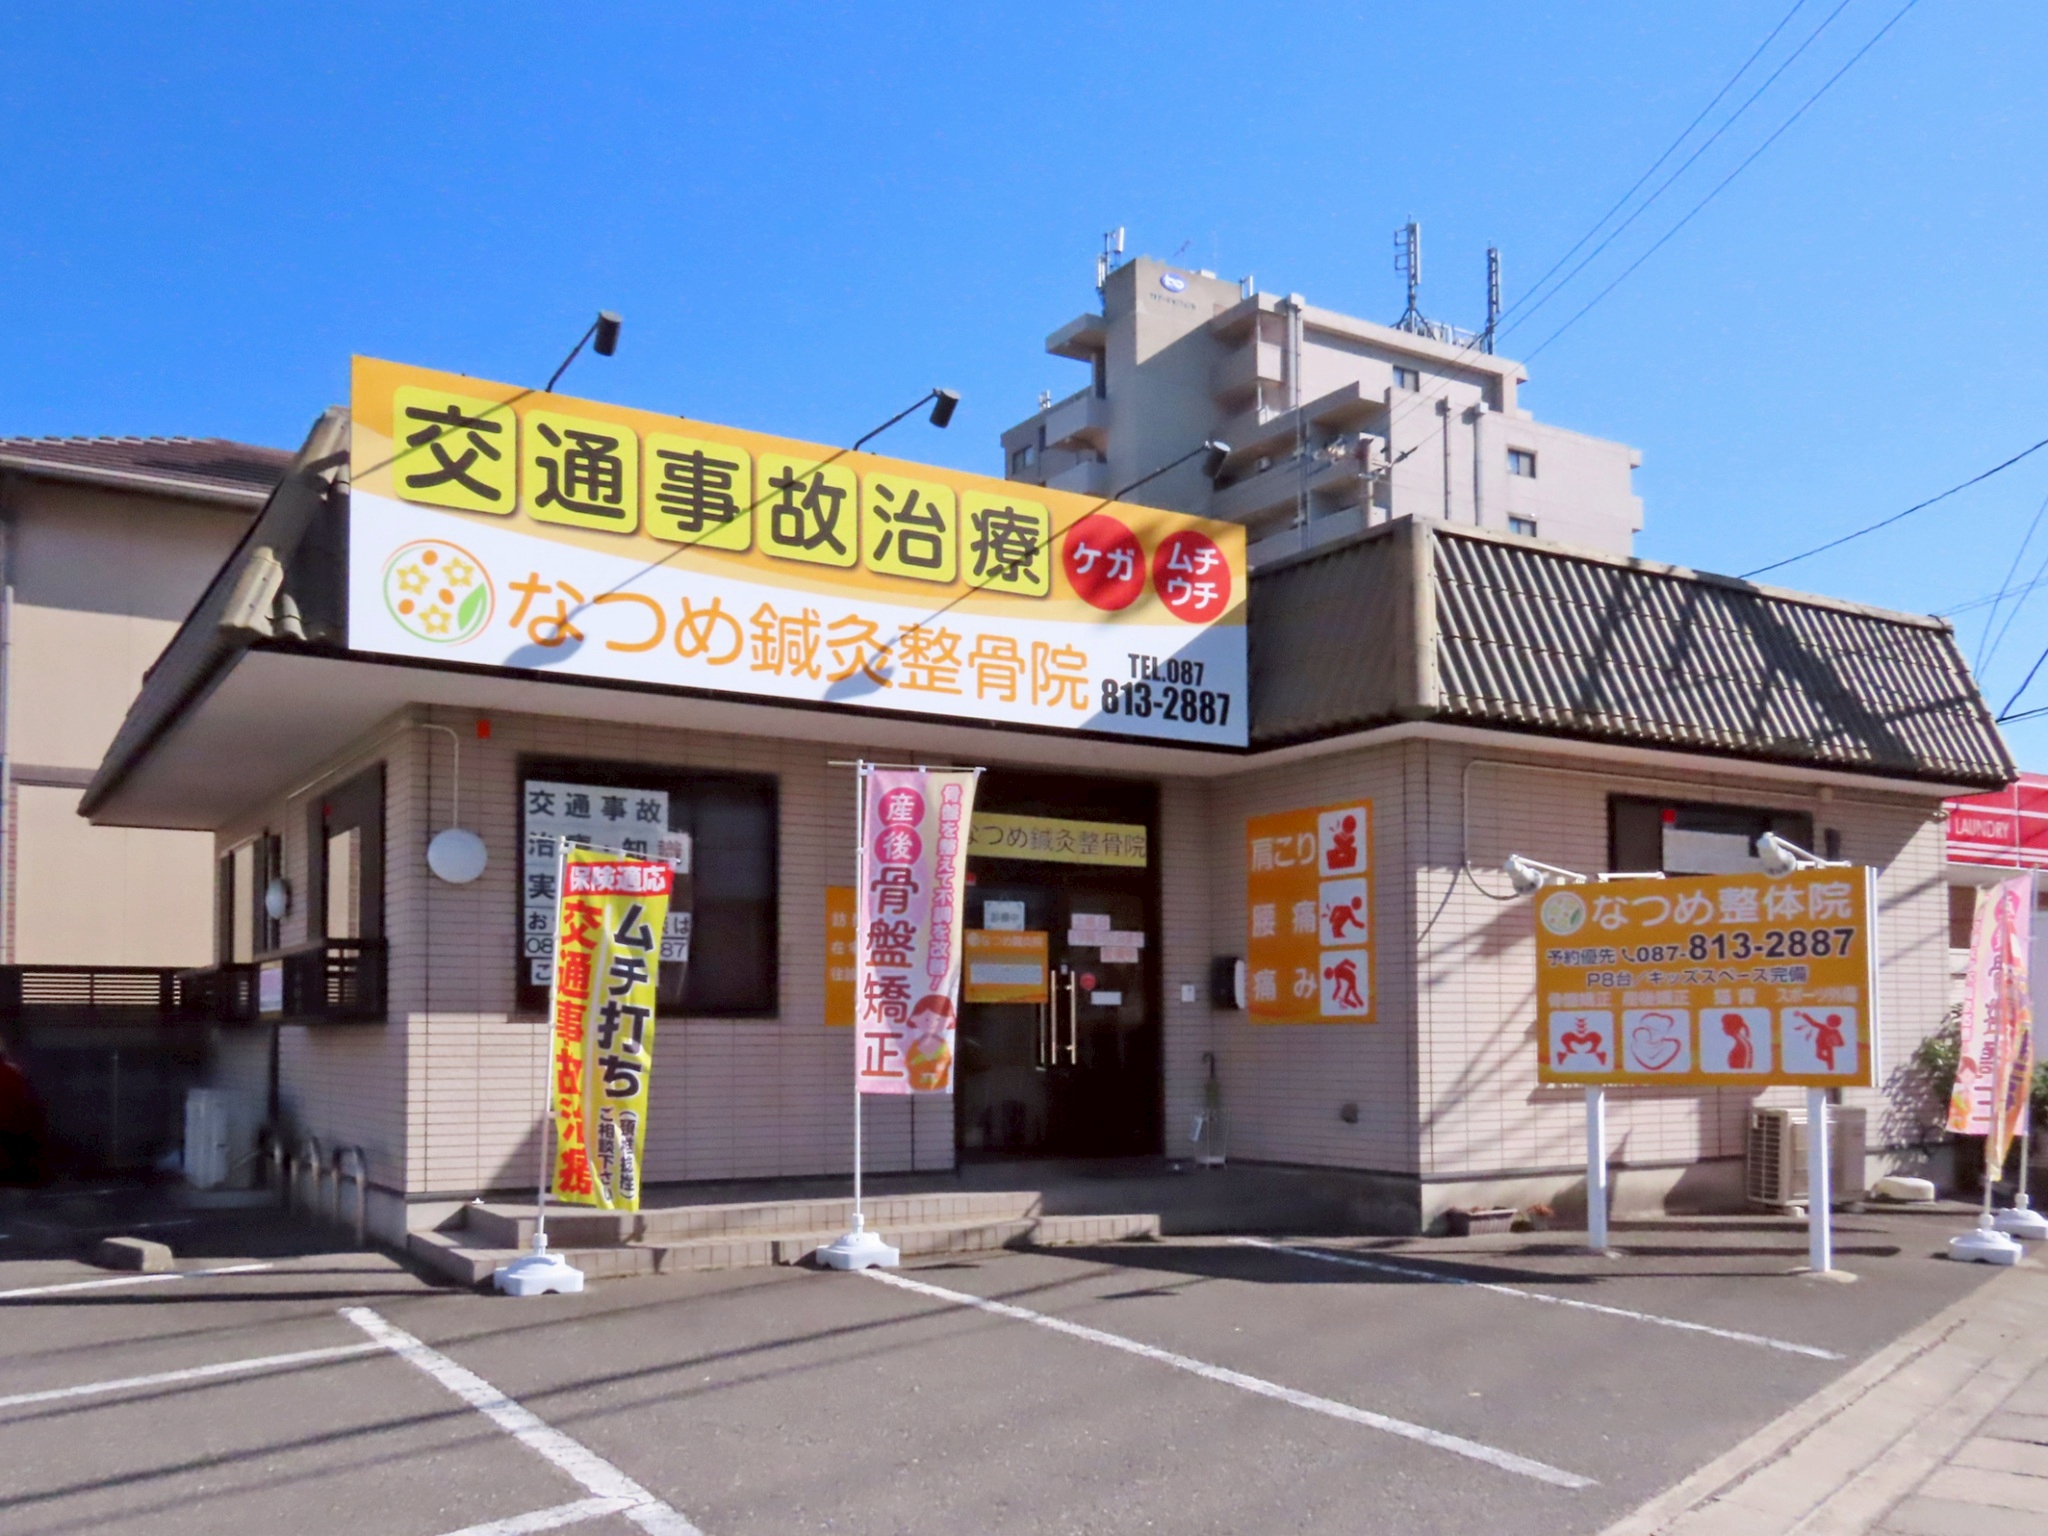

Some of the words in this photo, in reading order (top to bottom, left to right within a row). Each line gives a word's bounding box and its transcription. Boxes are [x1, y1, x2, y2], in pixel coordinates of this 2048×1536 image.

[404, 403, 1041, 587] 交通事故治療
[1072, 541, 1135, 582] ケガ
[1167, 541, 1219, 573] ムチ
[1167, 579, 1219, 611] ウチ
[508, 571, 1090, 711] なつめ鍼灸整骨院
[1127, 652, 1205, 687] TEL.087
[1101, 679, 1231, 727] 813-2887
[528, 790, 662, 824] 交通事故
[1955, 817, 2010, 839] LAUNDRY
[1251, 831, 1317, 871] 肩こり
[569, 864, 667, 893] 保険適応
[1591, 880, 1853, 931] なつめ整体院
[1546, 948, 1617, 967] 予約優先
[1636, 928, 1856, 964] 087-813-2887
[595, 902, 654, 1099] ムチ打ち
[1252, 967, 1318, 1002] 痛み
